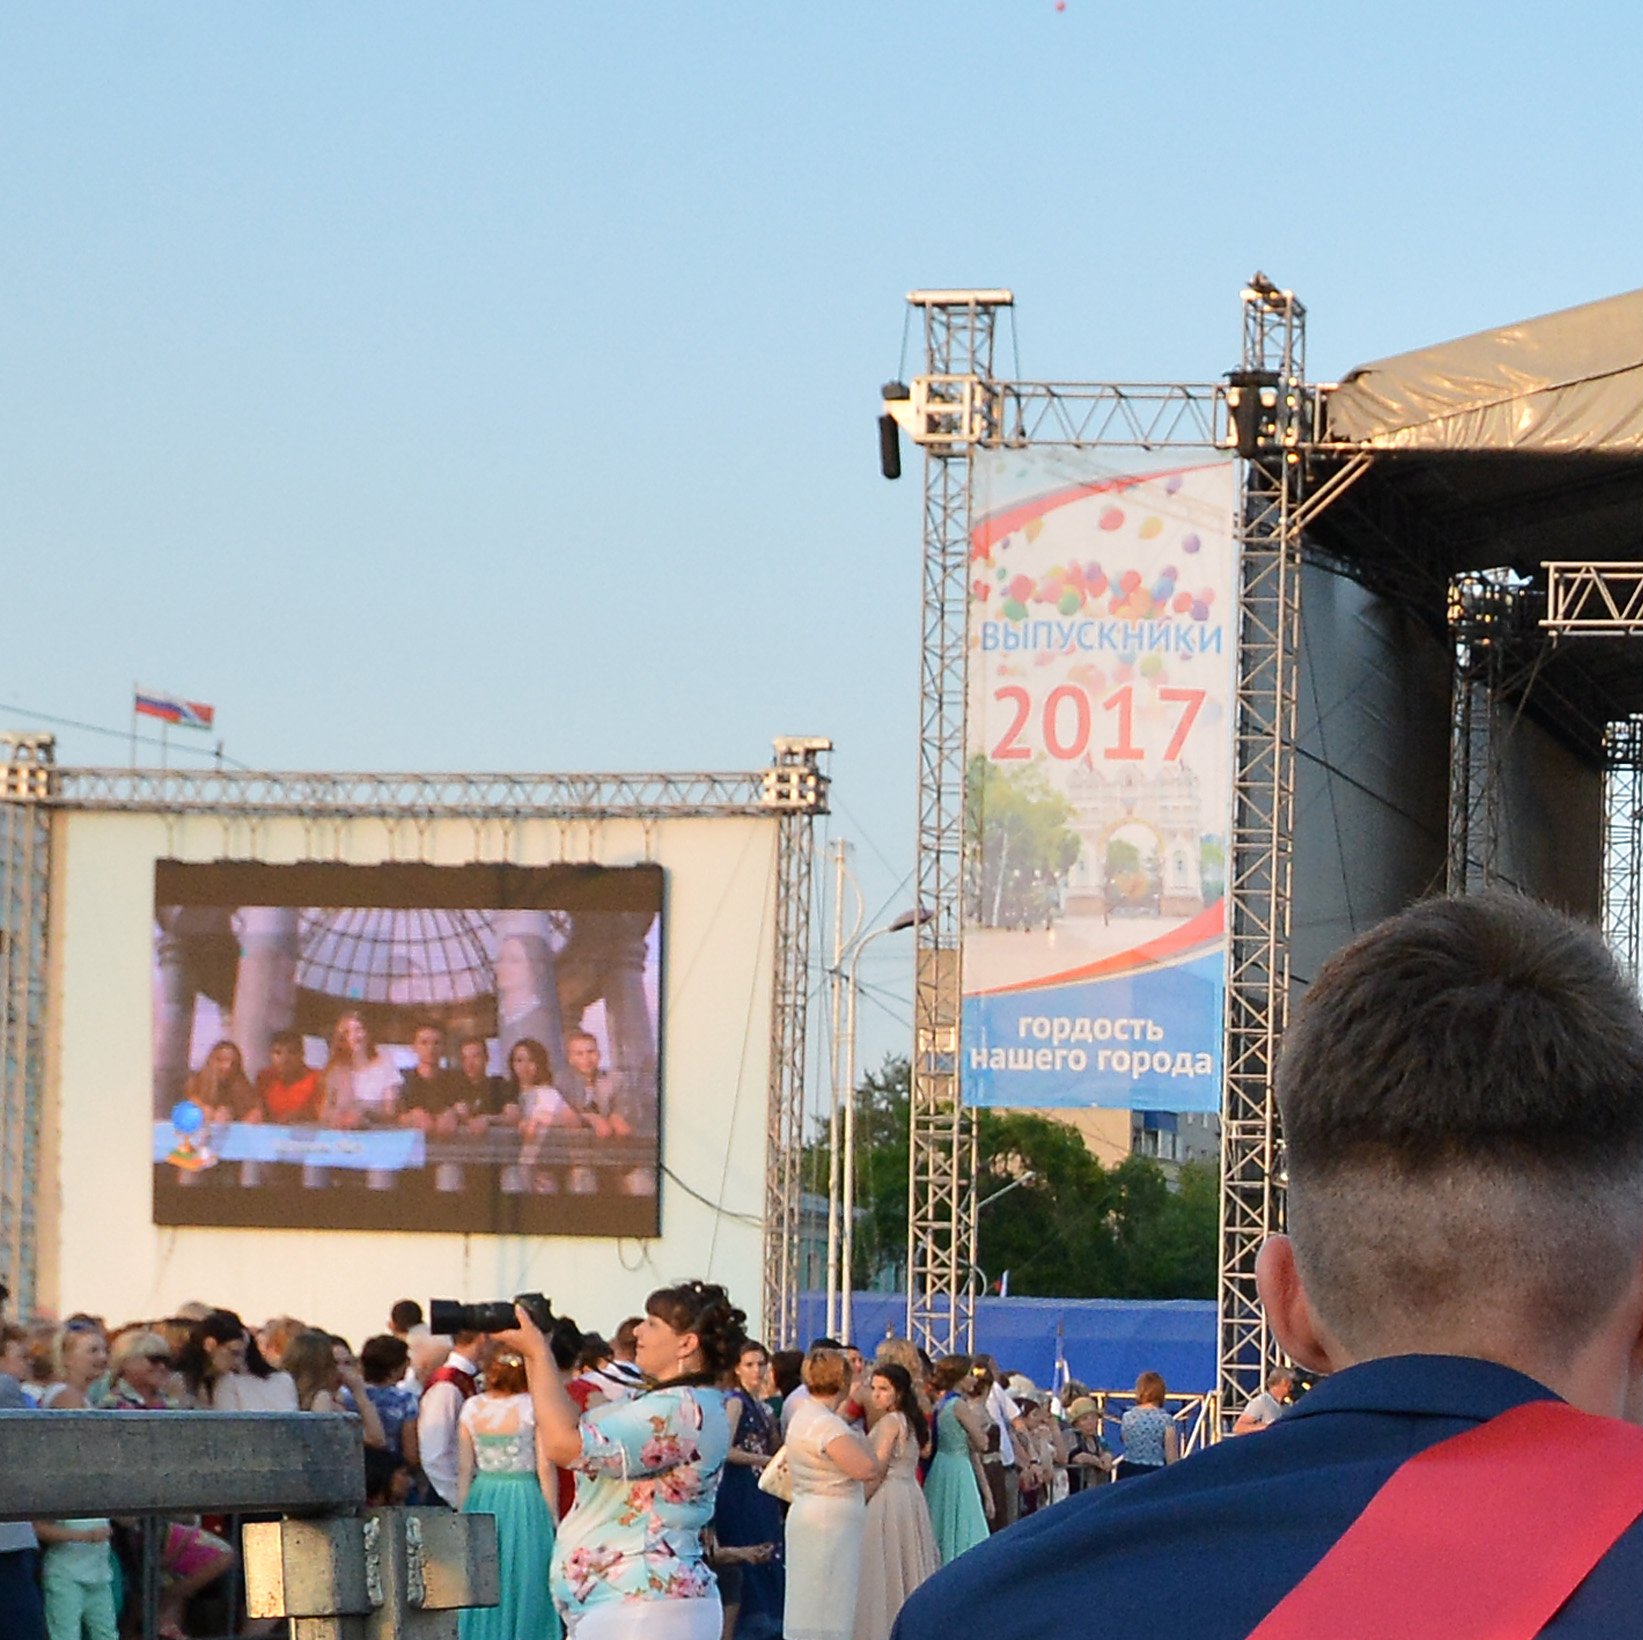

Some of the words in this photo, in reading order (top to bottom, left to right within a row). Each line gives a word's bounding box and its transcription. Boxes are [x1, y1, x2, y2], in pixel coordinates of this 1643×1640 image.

[981, 620, 1223, 654] ВЫПУСКНИКИ
[990, 683, 1207, 761] 2017
[1018, 1015, 1165, 1046] гордость
[970, 1047, 1088, 1072] нашего
[1097, 1050, 1214, 1080] города
